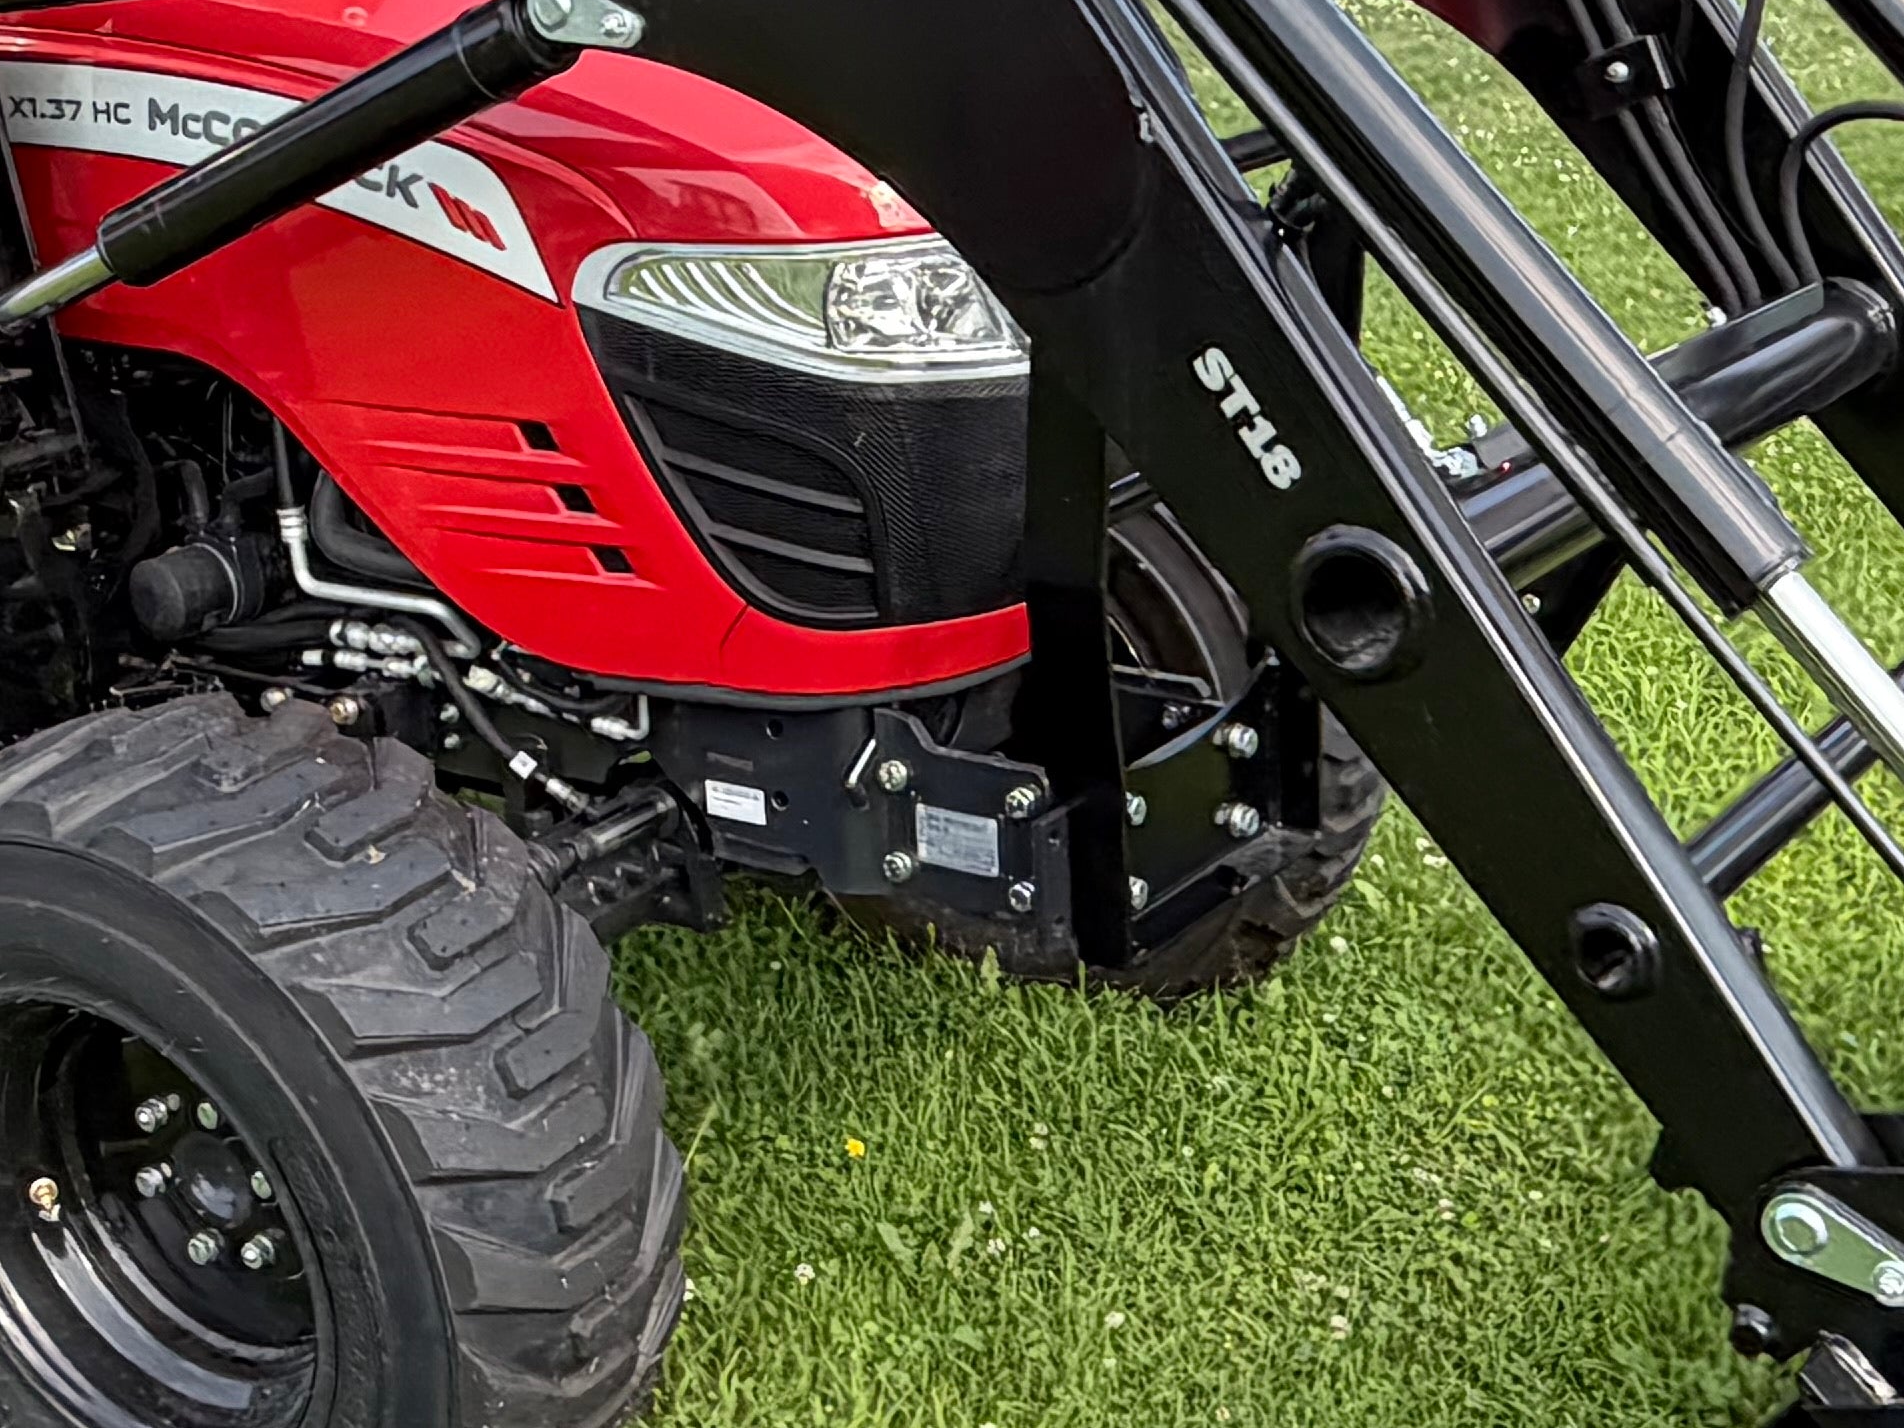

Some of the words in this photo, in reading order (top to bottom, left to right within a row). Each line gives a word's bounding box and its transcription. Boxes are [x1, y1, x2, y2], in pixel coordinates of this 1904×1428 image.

[8, 95, 83, 122] X1.37
[92, 100, 132, 125] HC
[1192, 347, 1302, 490] ST18
